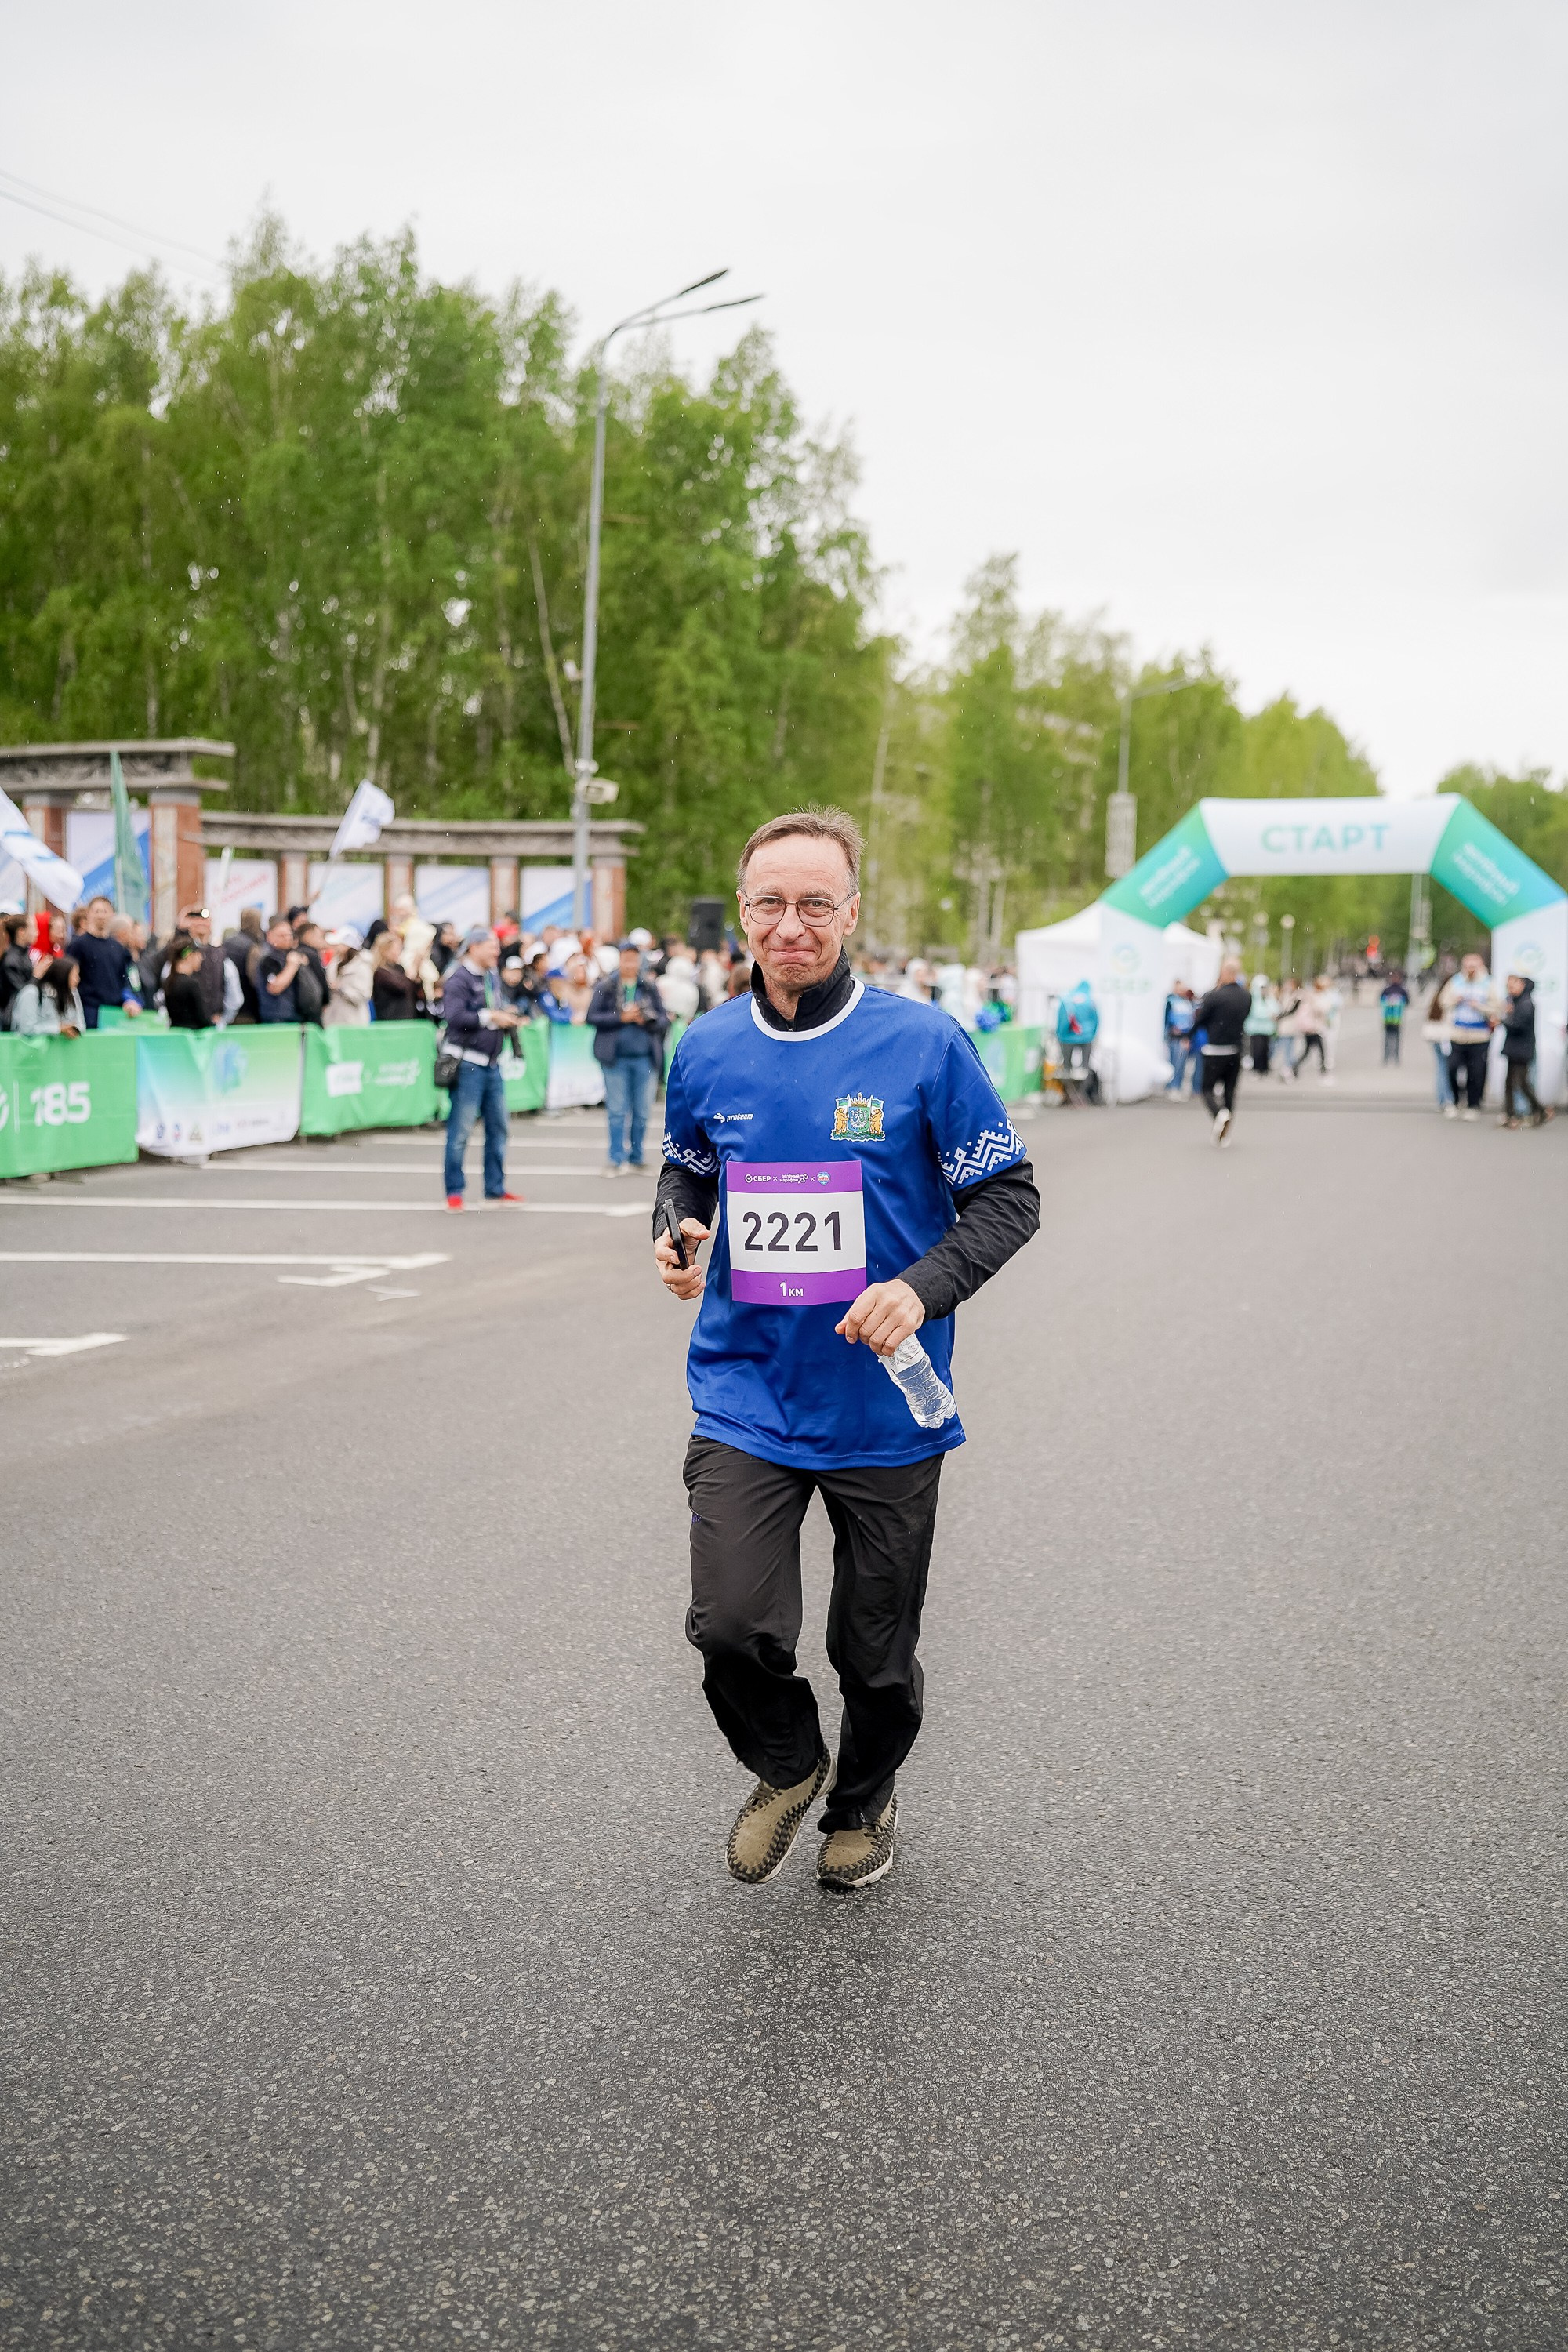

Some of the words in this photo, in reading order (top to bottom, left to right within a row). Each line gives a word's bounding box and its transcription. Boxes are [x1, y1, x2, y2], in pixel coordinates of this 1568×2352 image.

[1261, 823, 1389, 853] СТАРТ
[30, 1082, 92, 1126] 185
[727, 1113, 753, 1122] proteam
[742, 1211, 842, 1252] 2221
[779, 1281, 786, 1296] 1
